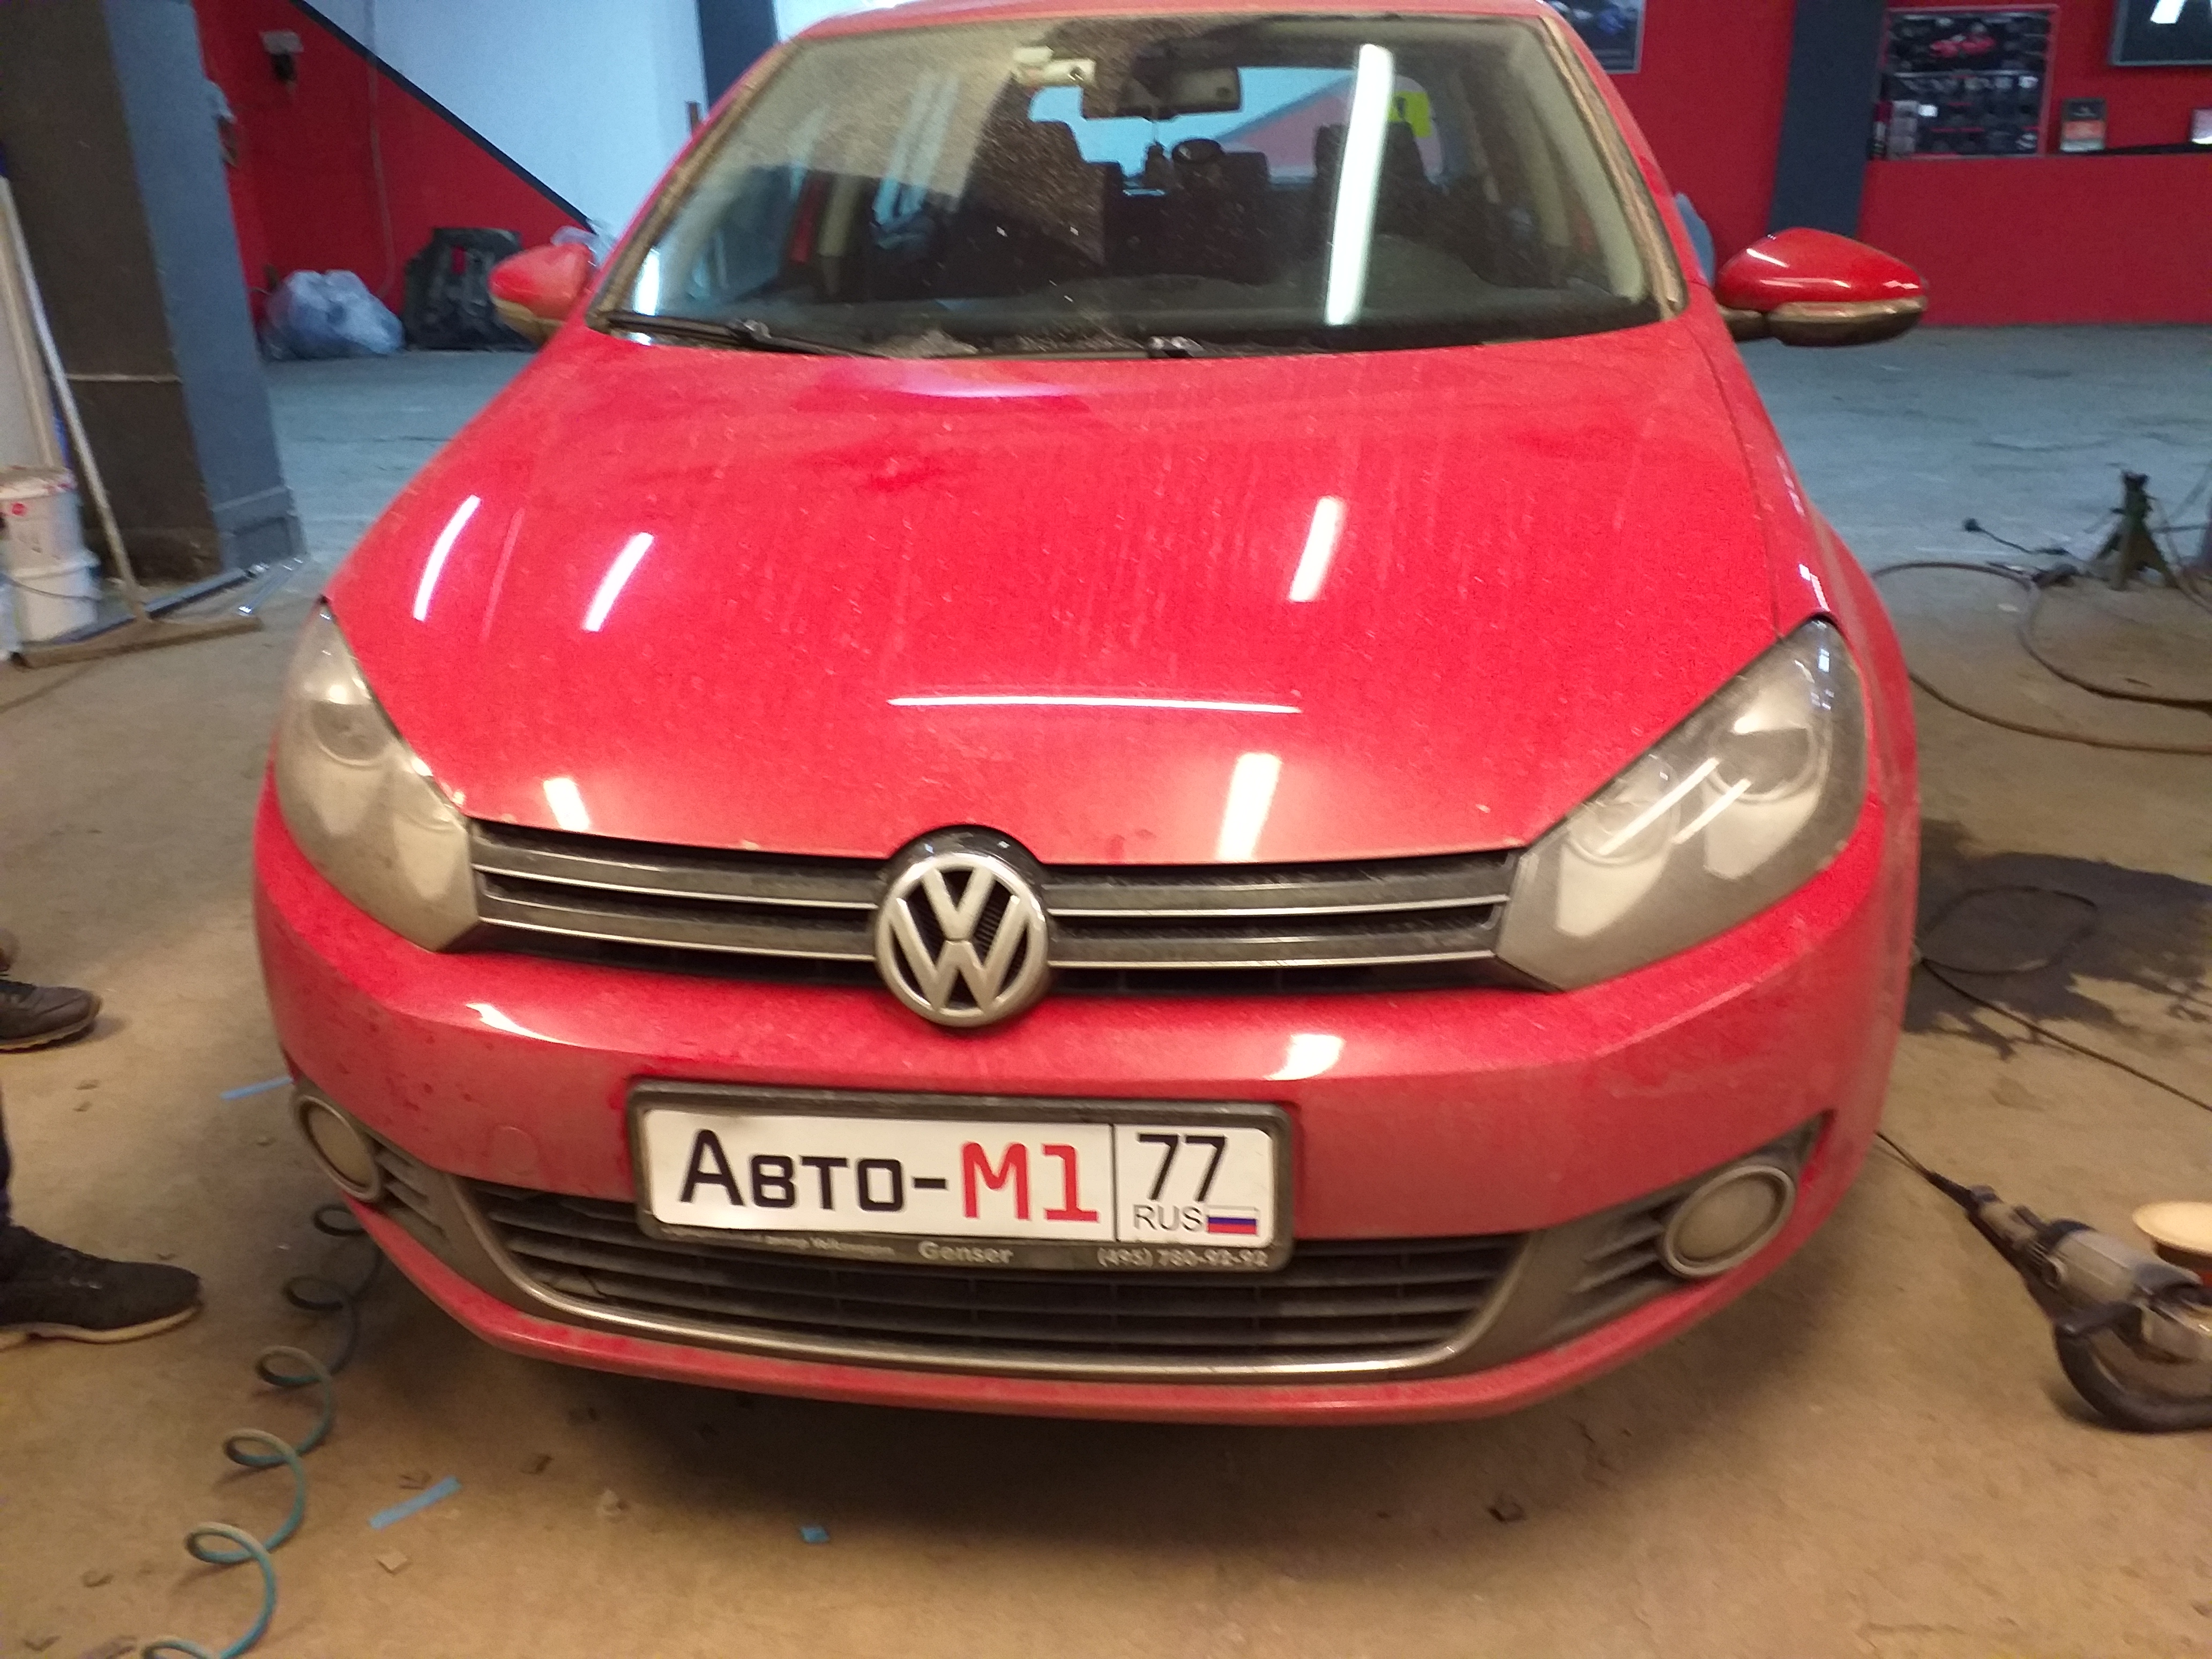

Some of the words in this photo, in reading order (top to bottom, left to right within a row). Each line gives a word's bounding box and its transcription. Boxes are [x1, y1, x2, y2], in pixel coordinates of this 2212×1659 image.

[1137, 1133, 1226, 1201] 77
[1133, 1204, 1204, 1232] RUS
[917, 1240, 1013, 1264] Genser
